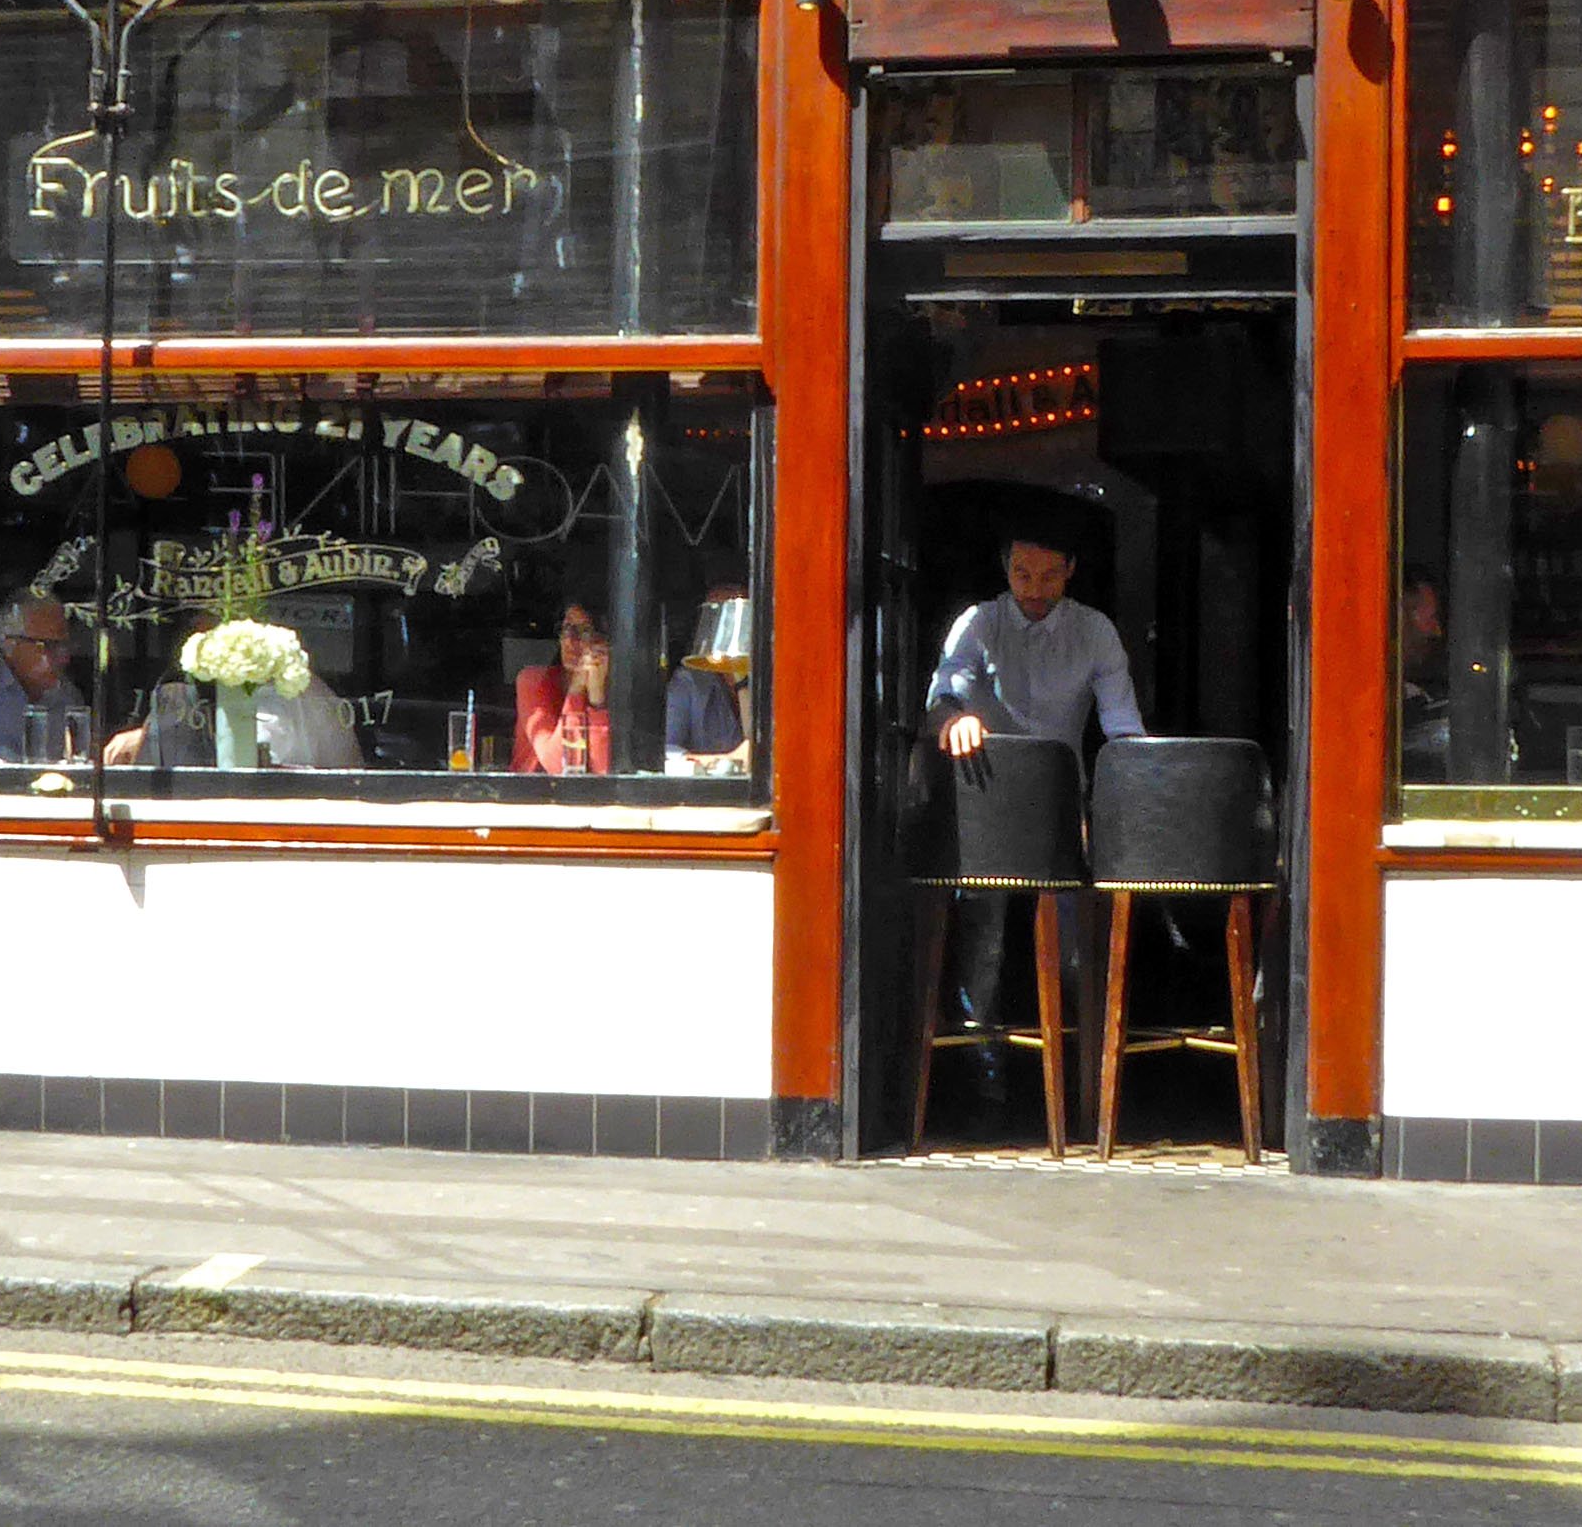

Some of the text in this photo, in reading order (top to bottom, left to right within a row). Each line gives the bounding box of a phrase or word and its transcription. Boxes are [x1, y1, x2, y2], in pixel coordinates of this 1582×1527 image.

[28, 156, 538, 221] Fruits de mer
[380, 418, 525, 503] YEARS
[151, 562, 272, 598] Randall
